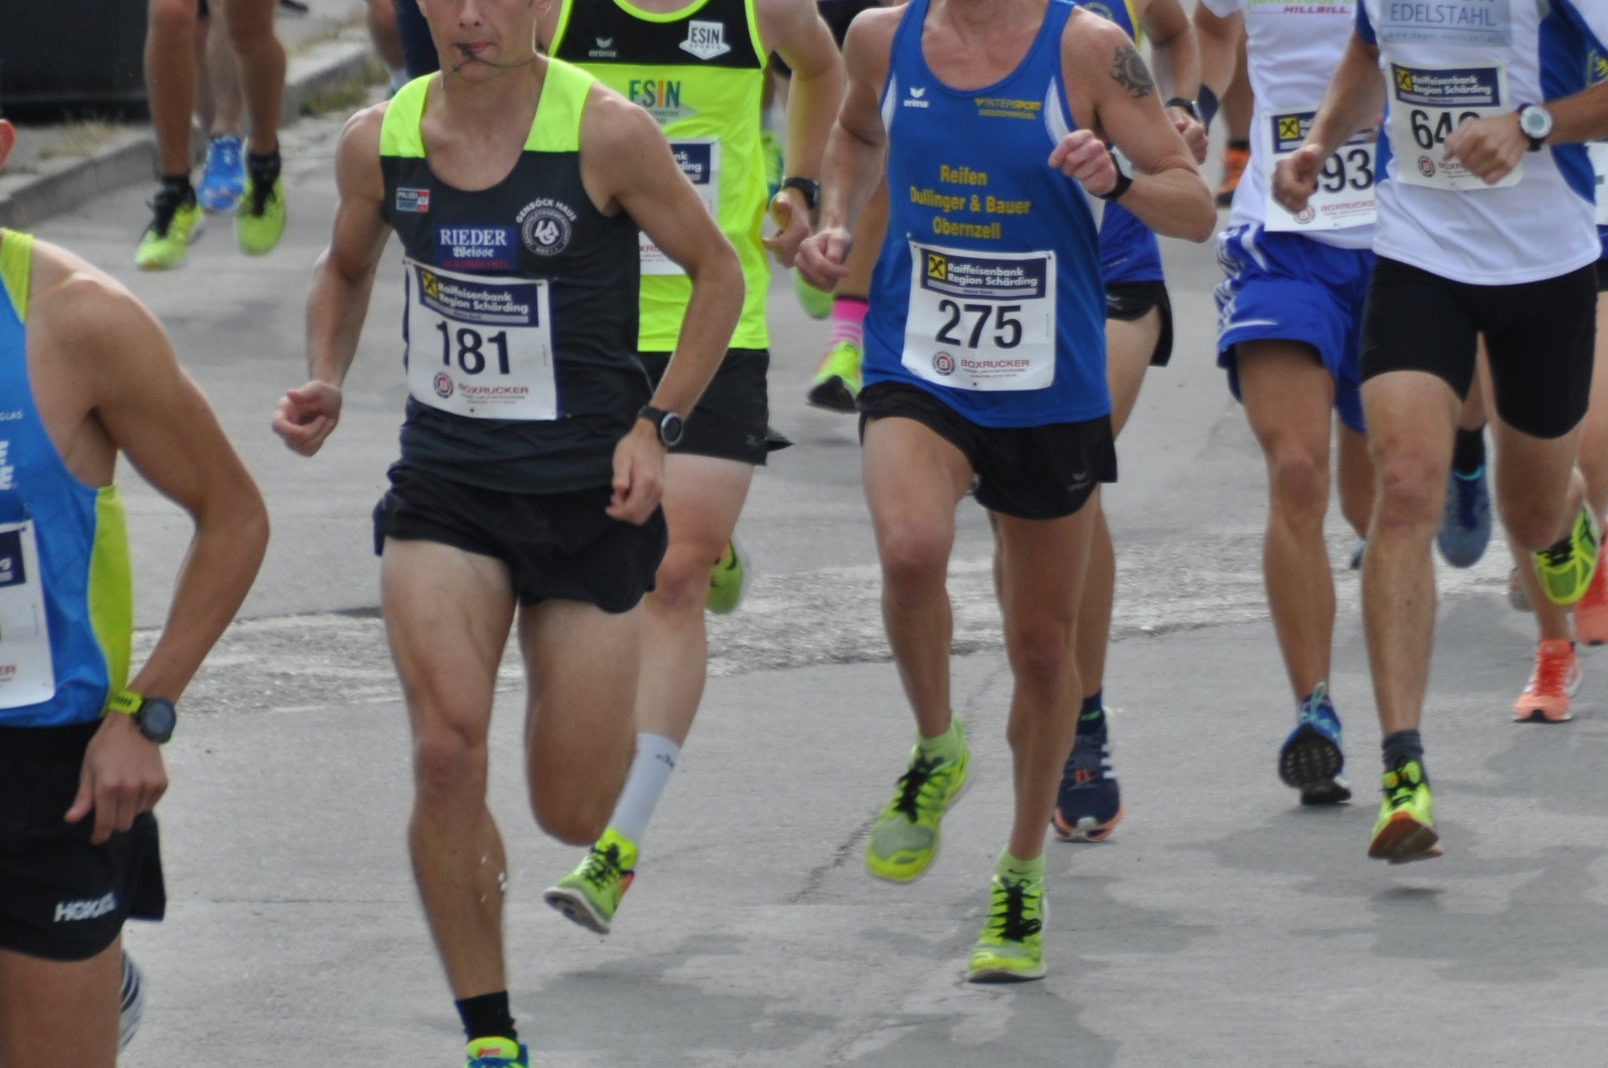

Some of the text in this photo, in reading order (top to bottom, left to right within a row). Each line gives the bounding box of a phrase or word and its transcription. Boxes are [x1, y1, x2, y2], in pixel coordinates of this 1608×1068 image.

[1389, 4, 1497, 27] EDELSTAHL
[691, 27, 722, 45] ESIN
[588, 49, 617, 58] erima
[629, 79, 682, 109] ESIN
[903, 99, 929, 109] erima
[983, 99, 1042, 111] INTERSPORT
[1410, 108, 1480, 150] 64
[940, 164, 988, 186] Reifen
[1313, 148, 1374, 194] 93
[909, 185, 1032, 215] Dullinger & Bauer
[1320, 199, 1376, 213] BOXRUCKE
[555, 200, 578, 222] HAUS
[440, 227, 508, 247] RIEDER
[932, 216, 1002, 240] Obernzell
[452, 246, 495, 259] Weisse
[947, 263, 1025, 278] Raiffeisenbank
[947, 273, 1038, 288] Region Schärding
[438, 281, 512, 302] Raiffeisenbank
[438, 292, 529, 316] Region Schärding
[935, 298, 1023, 350] 275
[436, 320, 511, 376] 181
[961, 359, 1030, 370] BOXRUCKER
[458, 382, 529, 395] BOXRUCKER
